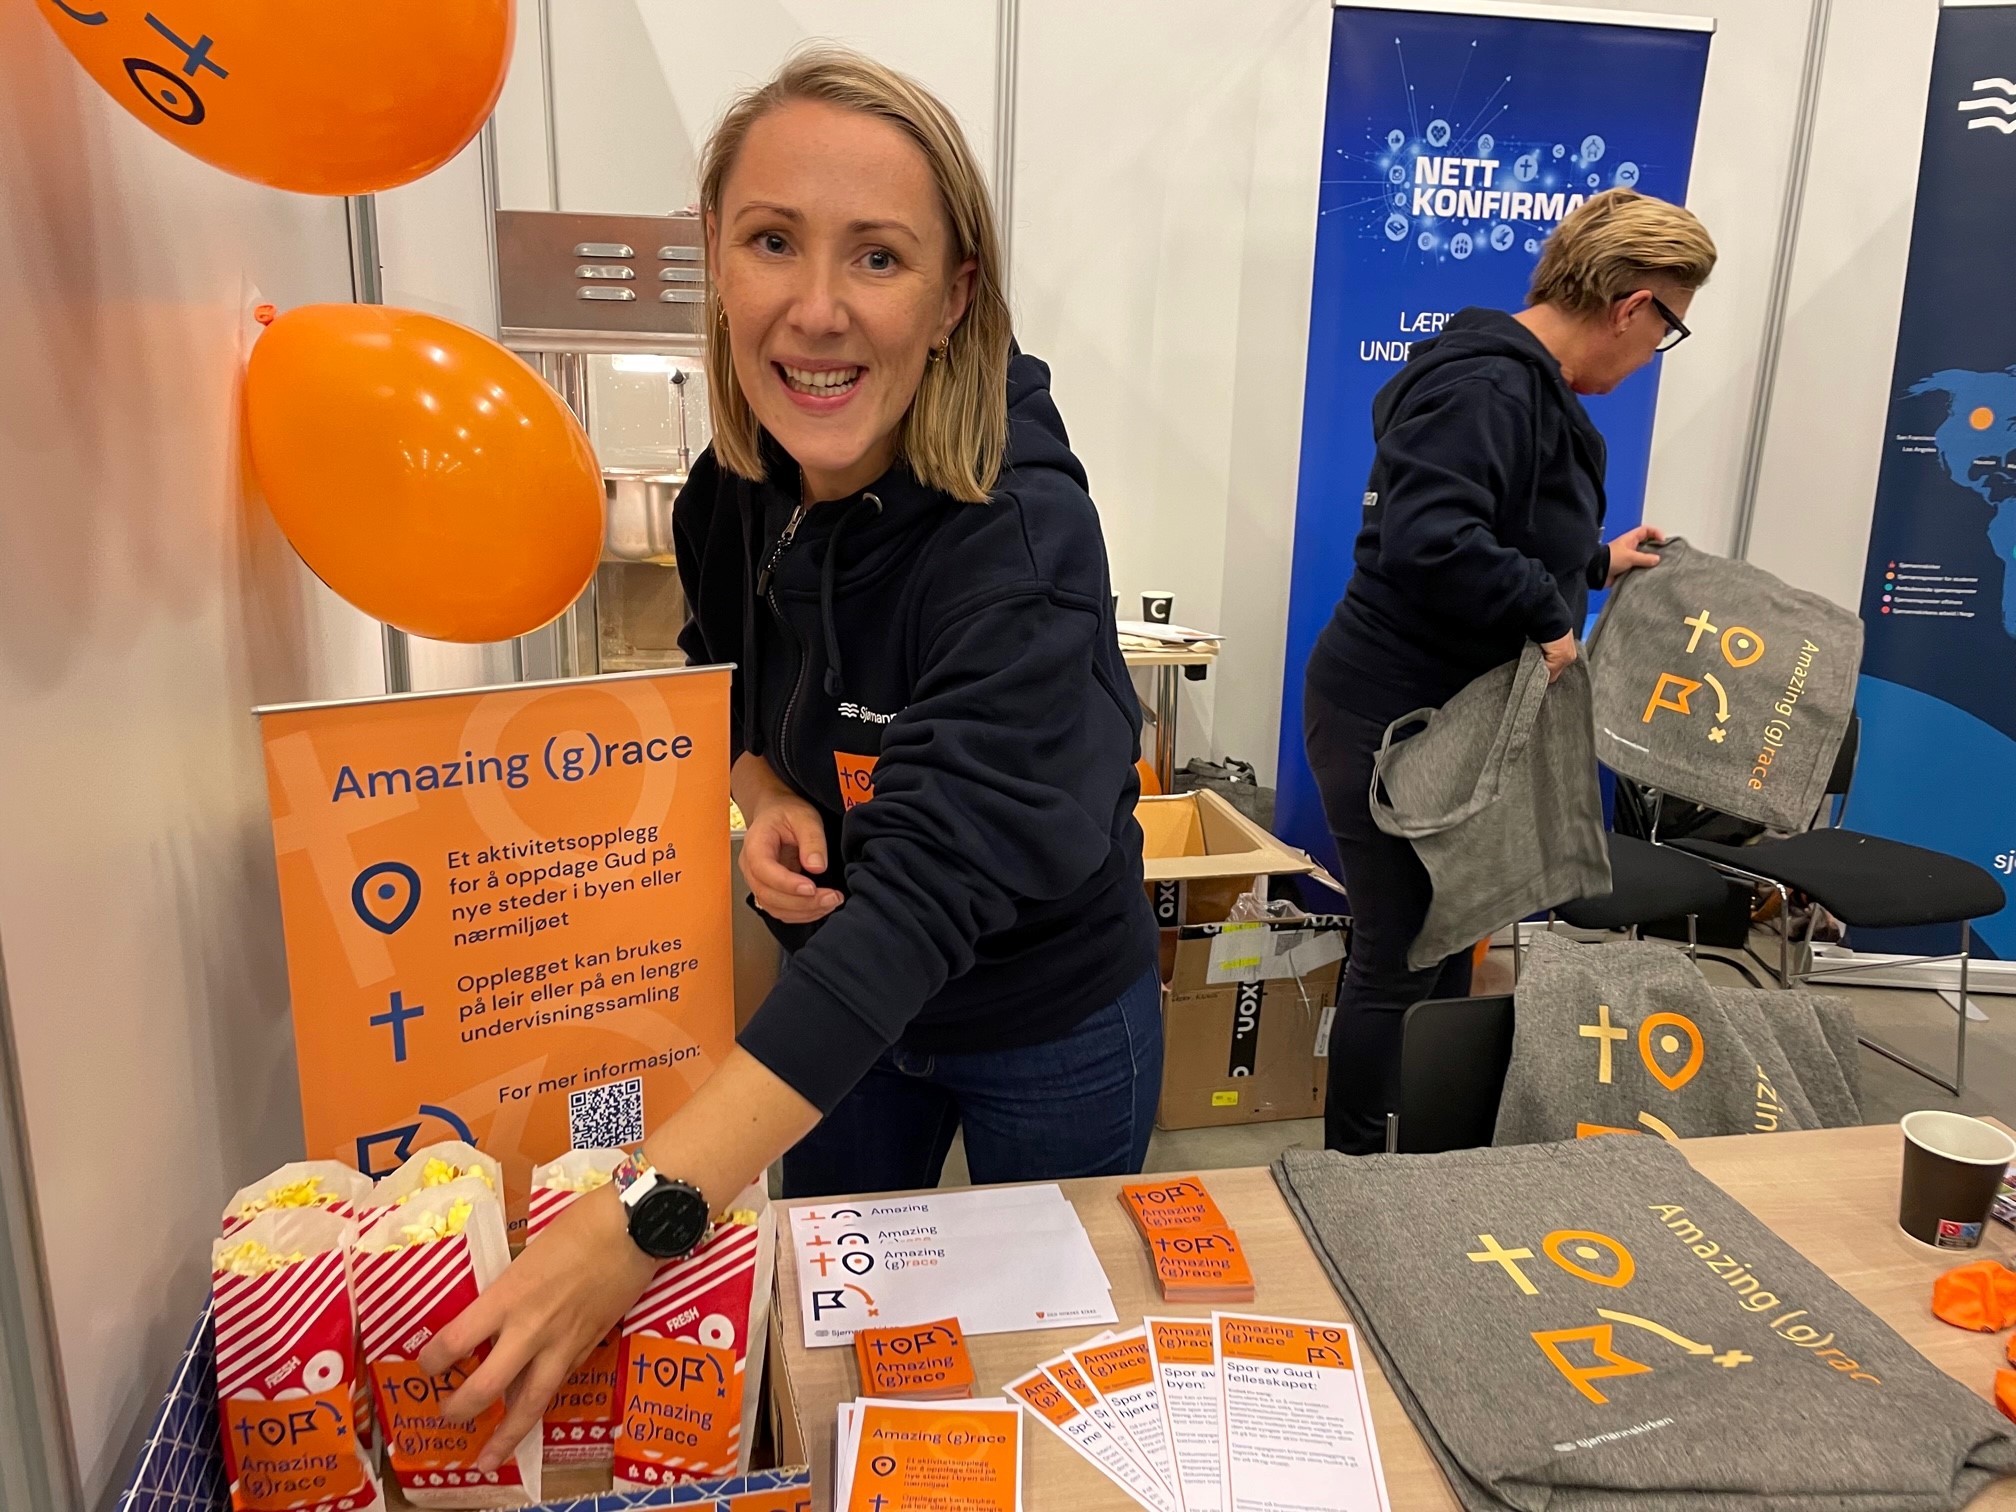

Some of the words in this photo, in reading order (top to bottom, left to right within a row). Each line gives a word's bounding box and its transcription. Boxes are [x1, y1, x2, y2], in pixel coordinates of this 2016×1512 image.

[1414, 156, 1500, 187] NETT
[1412, 187, 1595, 221] KONFIRMA
[1400, 312, 1455, 332] LÆRI
[1150, 599, 1166, 619] C
[1774, 639, 1820, 718] Amazing
[1748, 719, 1791, 790] (g)race
[331, 750, 530, 802] Amazing
[543, 732, 693, 782] (g)race
[448, 851, 471, 869] Et
[477, 826, 658, 864] aktivitetsopplegg
[449, 877, 481, 895] for
[487, 869, 499, 888] å
[506, 859, 598, 886] oppdage
[604, 849, 647, 868] Gud
[652, 843, 676, 866] på
[1993, 850, 2016, 874] sj
[452, 902, 492, 922] nye
[499, 888, 567, 912] steder
[573, 884, 578, 899] i
[584, 877, 634, 899] byen
[641, 869, 681, 888] eller
[454, 912, 569, 947] nærmiljøet
[457, 958, 568, 993] Opplegget
[575, 948, 610, 969] kan
[616, 937, 682, 961] brukes
[459, 998, 486, 1022] på
[492, 992, 524, 1011] leir
[531, 982, 574, 1002] eller
[580, 973, 605, 995] på
[611, 970, 635, 986] en
[641, 957, 699, 981] lengre
[461, 985, 680, 1043] undervisningssamling
[1236, 984, 1259, 1039] xon.
[498, 1085, 531, 1103] For
[538, 1074, 578, 1095] mer
[583, 1044, 701, 1082] informasjon:
[871, 1204, 929, 1216] Amazing
[1143, 1204, 1206, 1216] Amazing
[1145, 1216, 1201, 1226] (g)race
[878, 1226, 938, 1239] Amazing
[884, 1248, 945, 1259] Amazing
[1160, 1257, 1230, 1269] Amazing
[885, 1259, 938, 1270] (g)race
[1161, 1267, 1222, 1278] (g)race
[1648, 1204, 1780, 1312] Amazing
[1769, 1310, 1882, 1386] (g)rac
[666, 1306, 700, 1332] FRESH
[1226, 1322, 1294, 1337] Amazing
[1226, 1332, 1285, 1346] (g)race
[876, 1356, 954, 1372] Amazing
[1084, 1344, 1149, 1365] Amazing
[265, 1356, 302, 1389] FRESH
[1090, 1357, 1146, 1377] (g)race
[1165, 1368, 1196, 1378] Spor
[1227, 1362, 1259, 1374] Spor
[1264, 1367, 1279, 1375] av
[1284, 1368, 1313, 1379] Gud
[1317, 1371, 1321, 1379] i
[878, 1372, 945, 1387] (g)race
[1167, 1380, 1205, 1390] byen:
[1228, 1374, 1318, 1391] fellesskapet:
[1111, 1393, 1141, 1406] Spor
[628, 1395, 712, 1431] Amazing
[1119, 1403, 1158, 1418] hjerte
[393, 1413, 477, 1433] Amazg
[627, 1417, 698, 1447] (g)race
[397, 1432, 468, 1455] (g)race
[873, 1429, 942, 1444] Amazing
[947, 1430, 1006, 1444] (g)race
[241, 1453, 338, 1474] Amazing
[243, 1474, 327, 1499] (g)race
